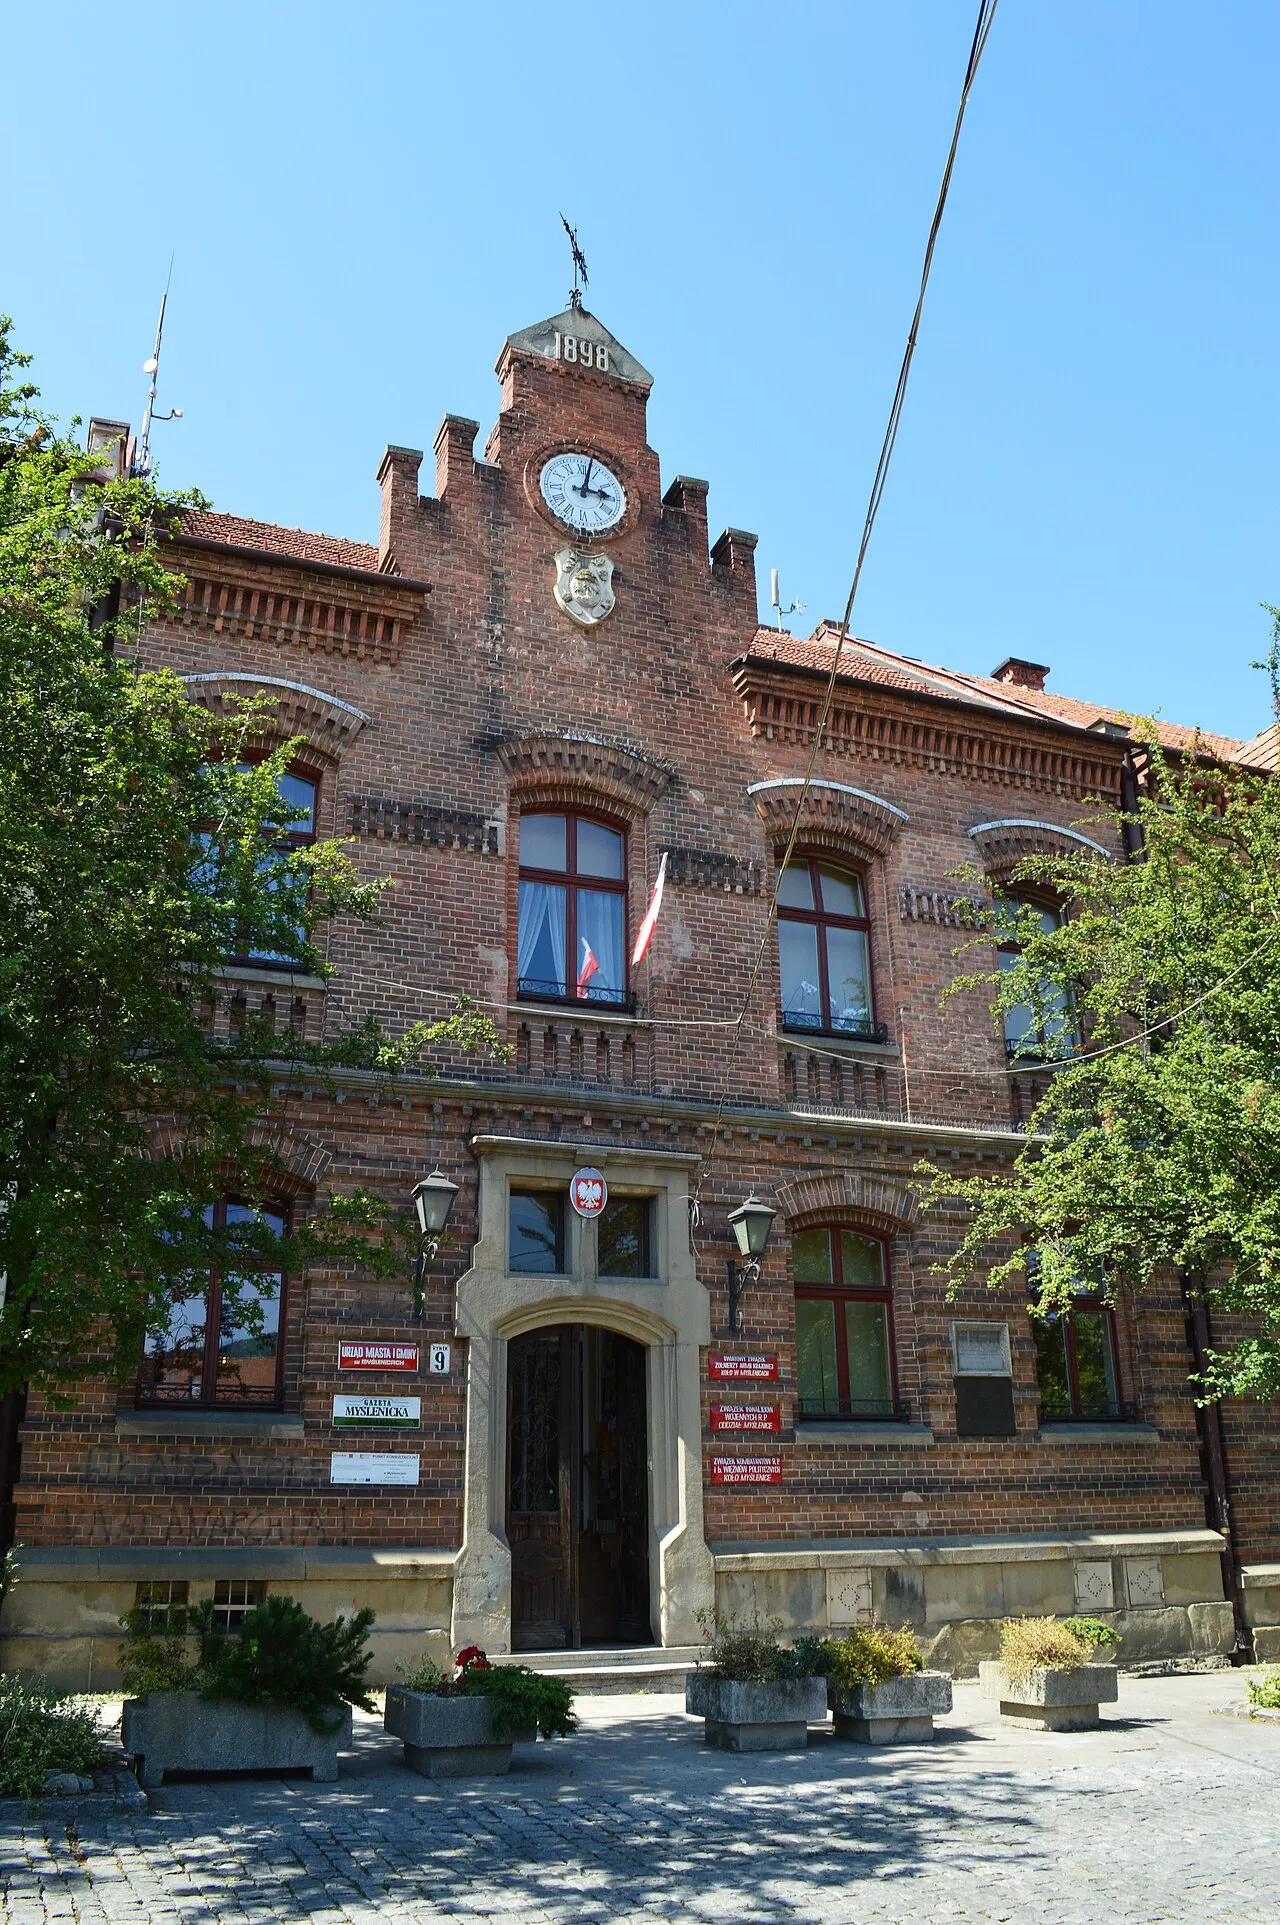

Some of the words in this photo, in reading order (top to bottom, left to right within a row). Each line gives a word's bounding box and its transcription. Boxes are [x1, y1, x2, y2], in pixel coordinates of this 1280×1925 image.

[555, 331, 609, 372] 1898
[341, 1346, 363, 1359] URZĄD
[365, 1347, 391, 1359] MIASTA
[396, 1348, 417, 1359] GMINY
[434, 1351, 445, 1371] 9
[363, 1399, 391, 1407] GAZETA
[725, 1412, 757, 1420] WOJENNYCH
[718, 1421, 741, 1429] ODDZIAŁ
[743, 1421, 773, 1429] MYŚLENICE
[749, 1465, 780, 1474] POLITYCZNYCH
[723, 1473, 739, 1482] KOŁO
[740, 1473, 771, 1482] MYŚLENICE
